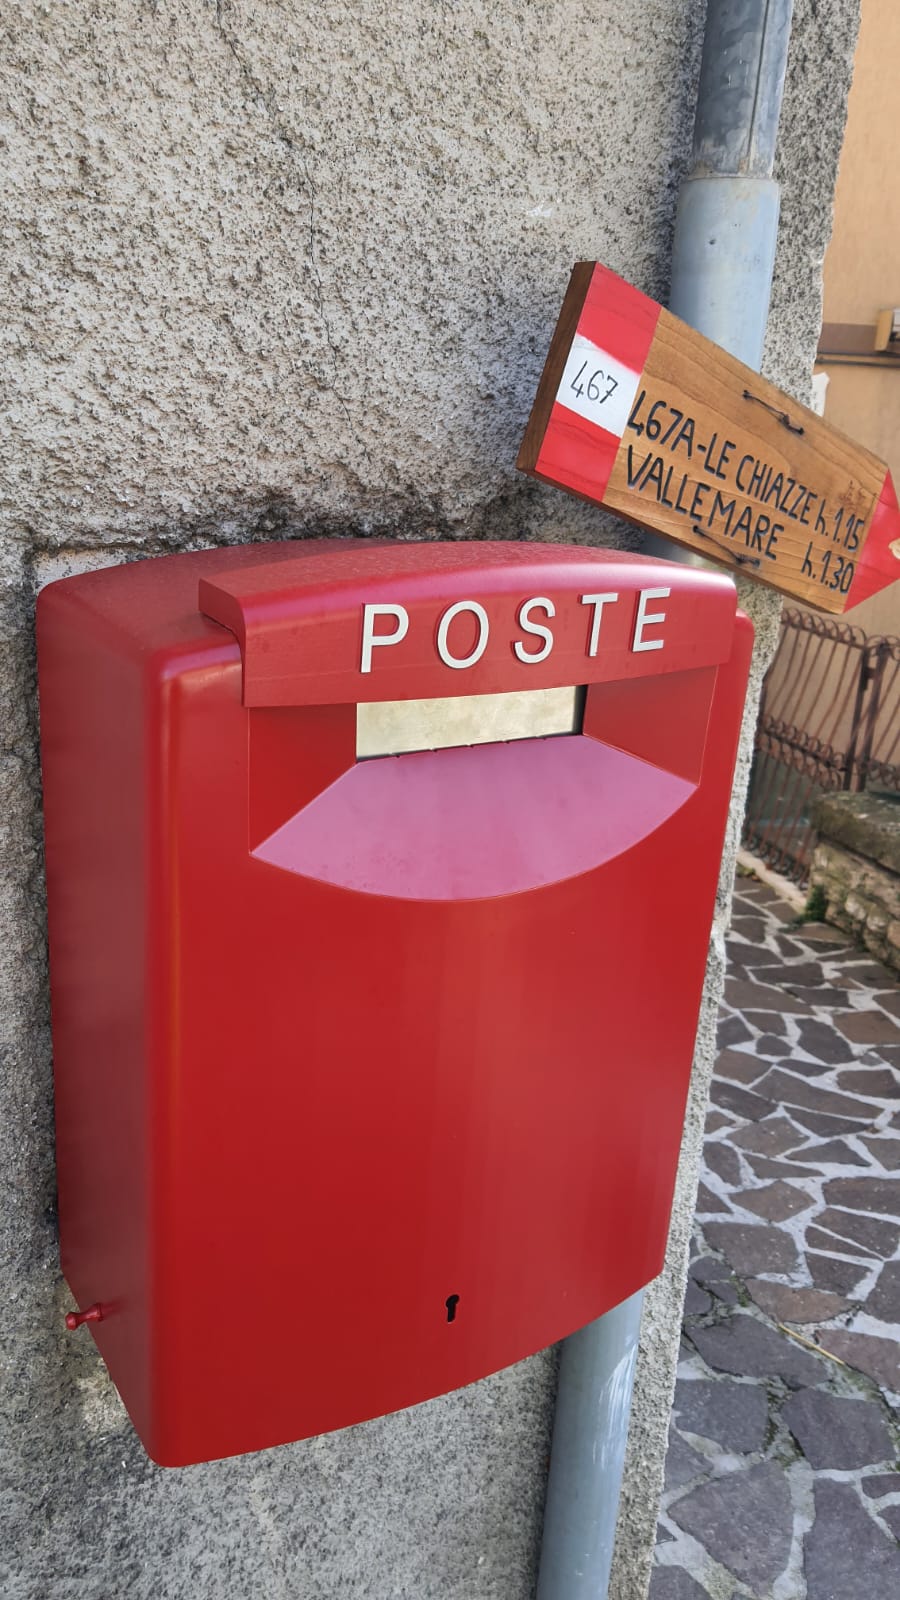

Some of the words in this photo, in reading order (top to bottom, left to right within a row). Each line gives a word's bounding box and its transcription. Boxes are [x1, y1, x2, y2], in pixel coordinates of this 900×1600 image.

[570, 360, 618, 403] 467
[627, 445, 784, 560] VALLEMARE
[801, 541, 854, 594] h.1.30
[735, 455, 817, 525] CHIAZZE
[360, 587, 671, 673] POSTE
